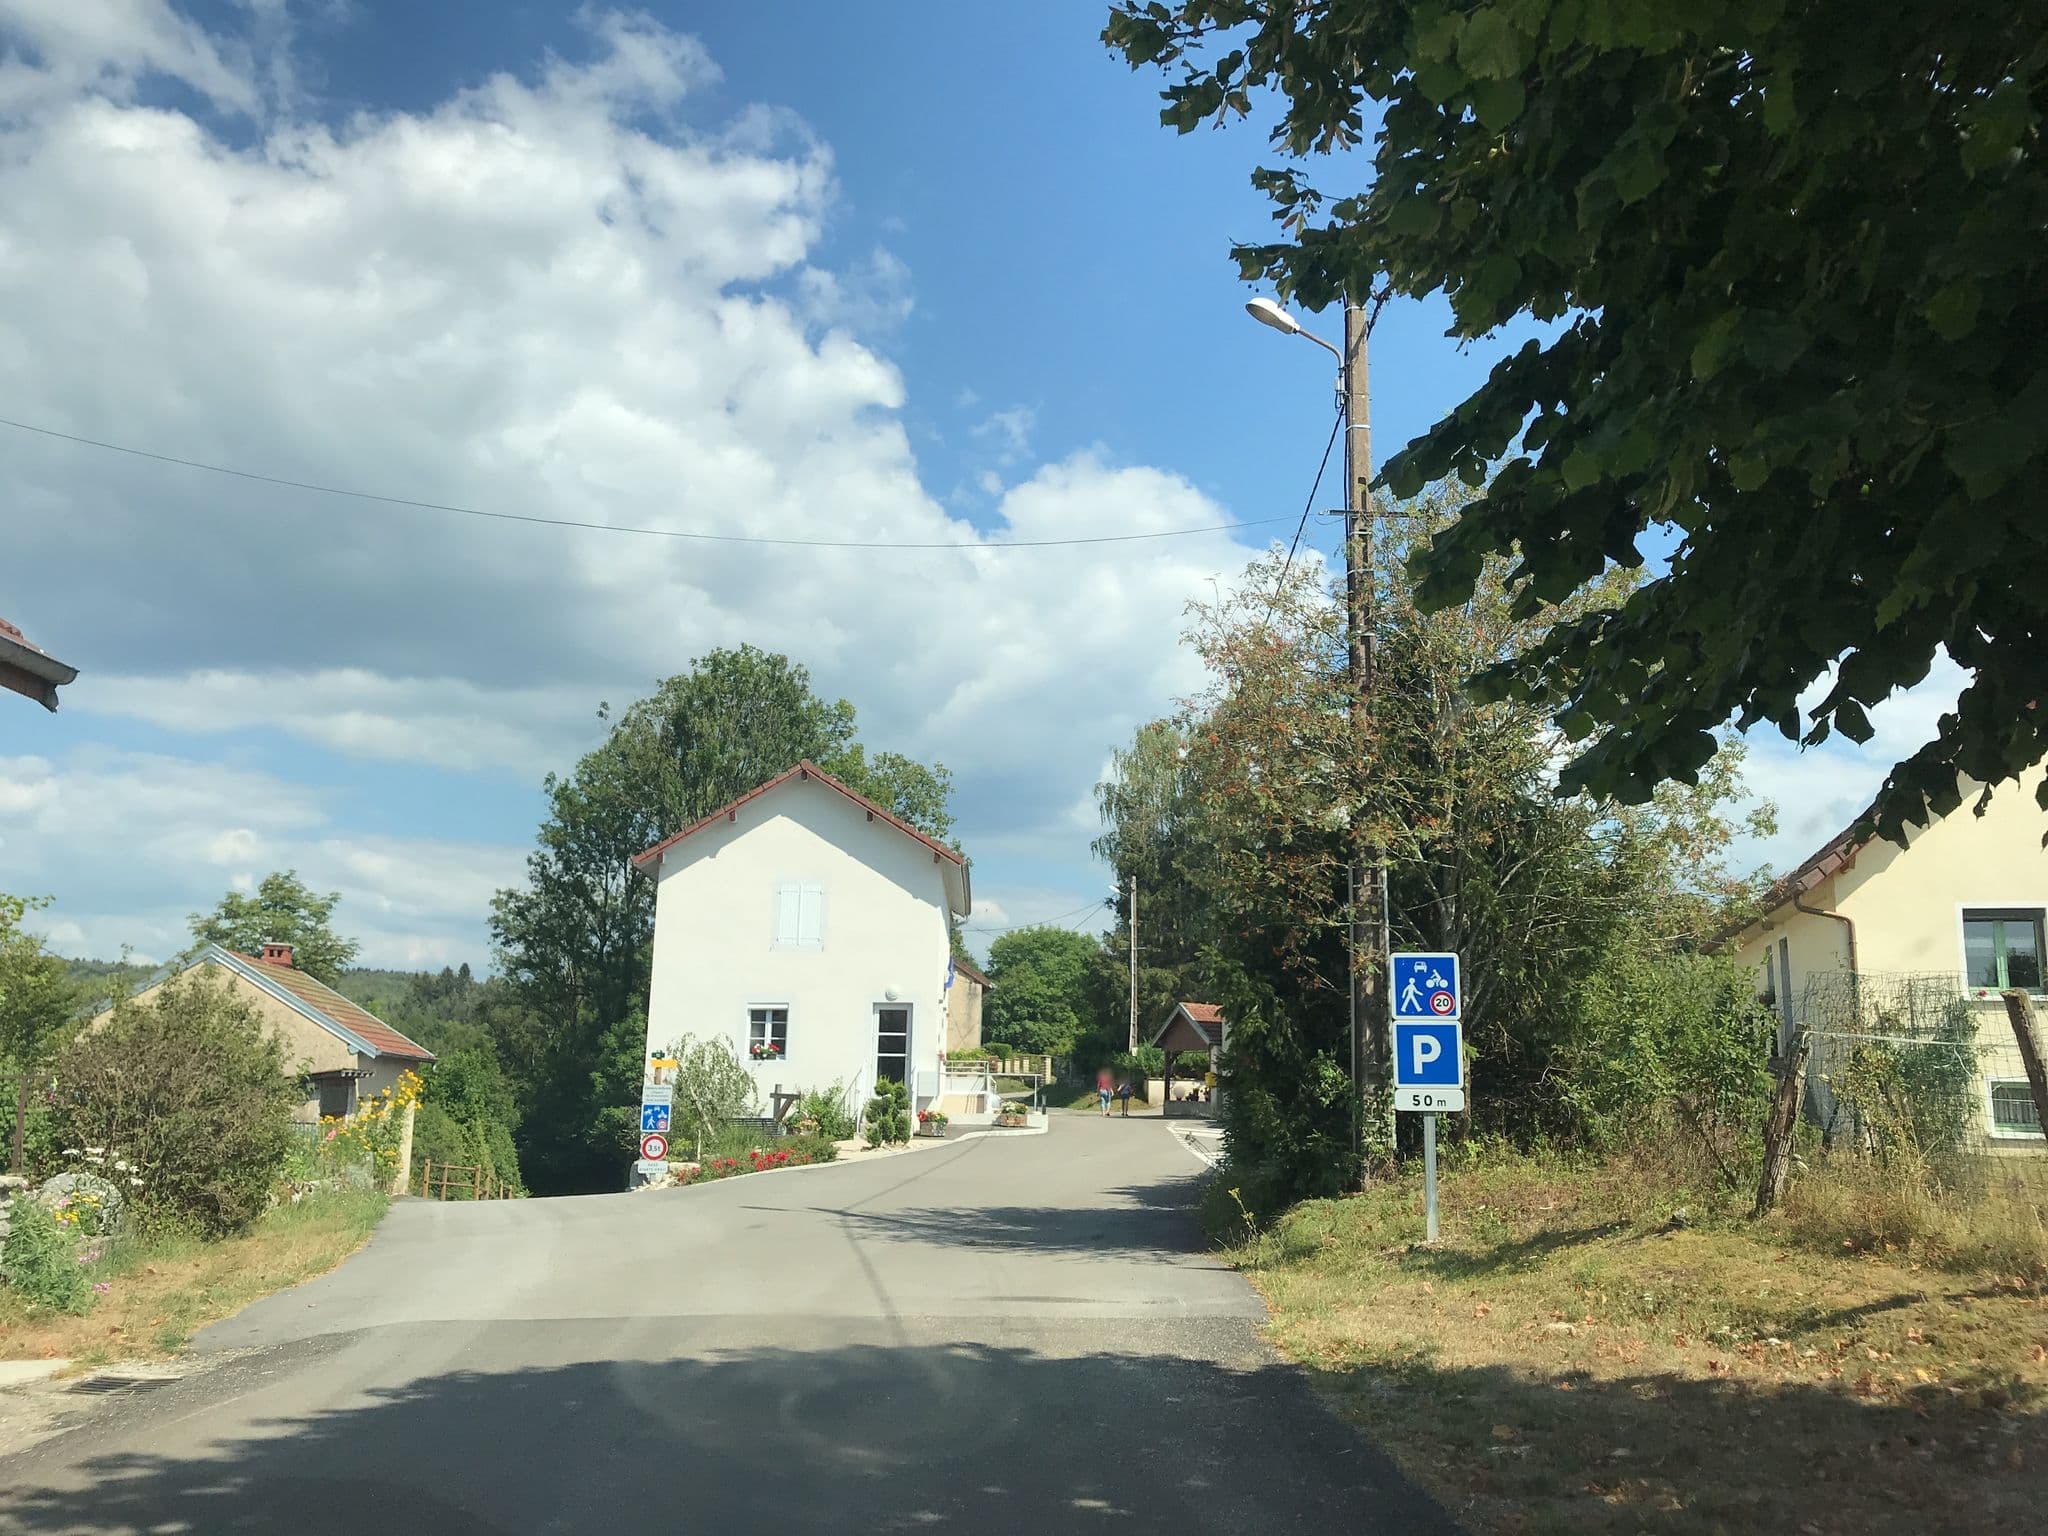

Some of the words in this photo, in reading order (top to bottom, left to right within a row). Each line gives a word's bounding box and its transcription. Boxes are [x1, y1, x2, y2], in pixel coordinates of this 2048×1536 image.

[1436, 998, 1448, 1007] 20
[1412, 1034, 1442, 1075] P
[1412, 1094, 1433, 1107] 50
